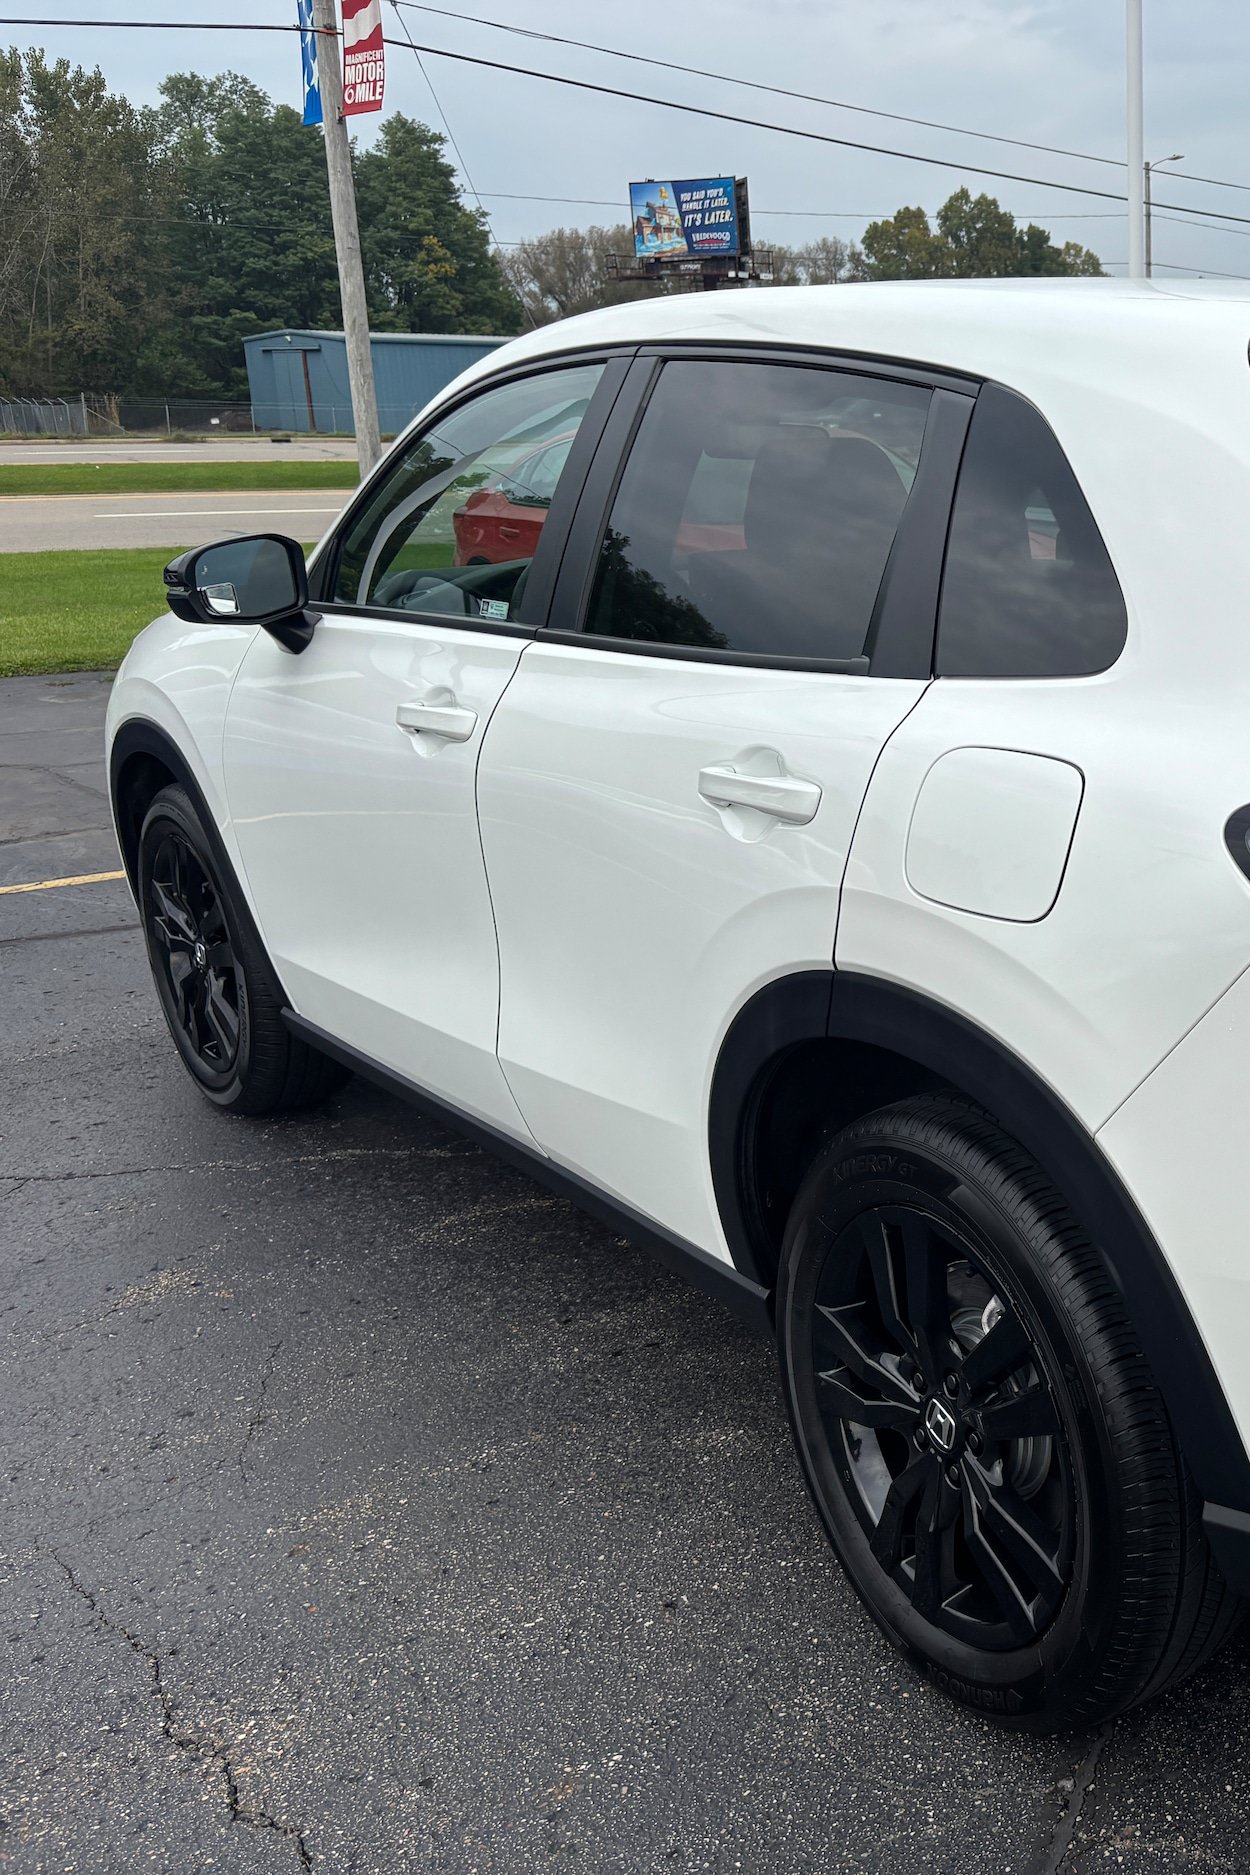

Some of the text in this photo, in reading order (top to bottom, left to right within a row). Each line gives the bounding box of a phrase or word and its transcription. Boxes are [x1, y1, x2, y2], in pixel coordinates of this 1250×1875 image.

[346, 49, 384, 65] MAGNIFICENT
[345, 61, 384, 85] MOTOR
[355, 82, 383, 103] MILE
[681, 193, 691, 202] YOU
[692, 191, 705, 200] SAID
[682, 202, 703, 211] HANDLE
[704, 200, 710, 208] IT
[684, 210, 733, 227] IT'S LATER.
